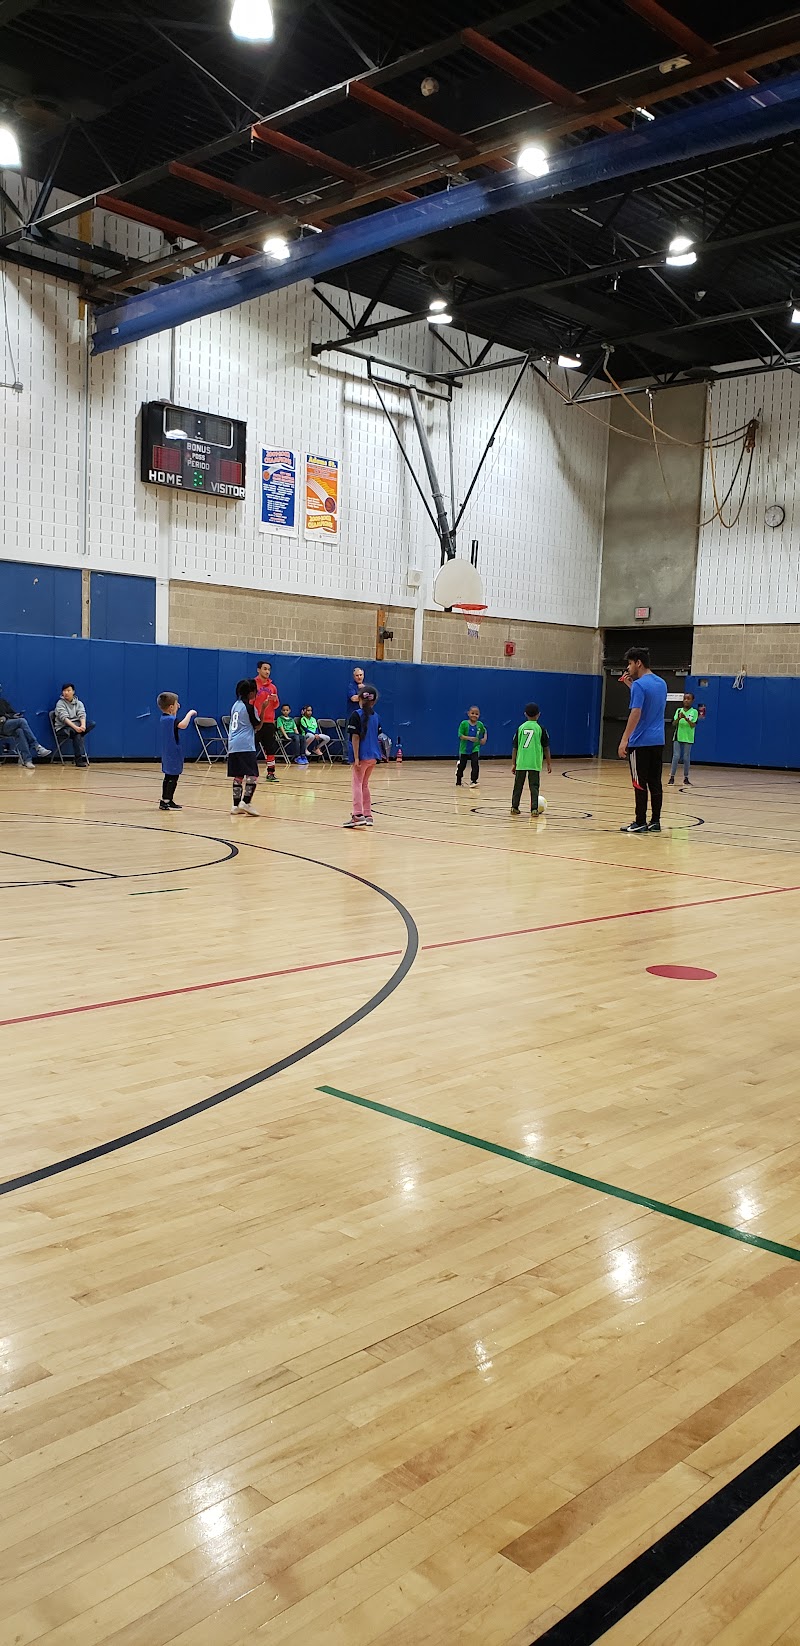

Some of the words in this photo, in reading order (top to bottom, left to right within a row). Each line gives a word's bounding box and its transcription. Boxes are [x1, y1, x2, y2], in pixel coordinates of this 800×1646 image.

[186, 442, 211, 454] BONUS
[187, 460, 210, 470] PERIOD
[192, 453, 205, 461] POSS
[149, 470, 183, 486] HOME
[210, 481, 245, 497] VISITOR
[231, 711, 239, 731] 8
[523, 729, 534, 748] 7
